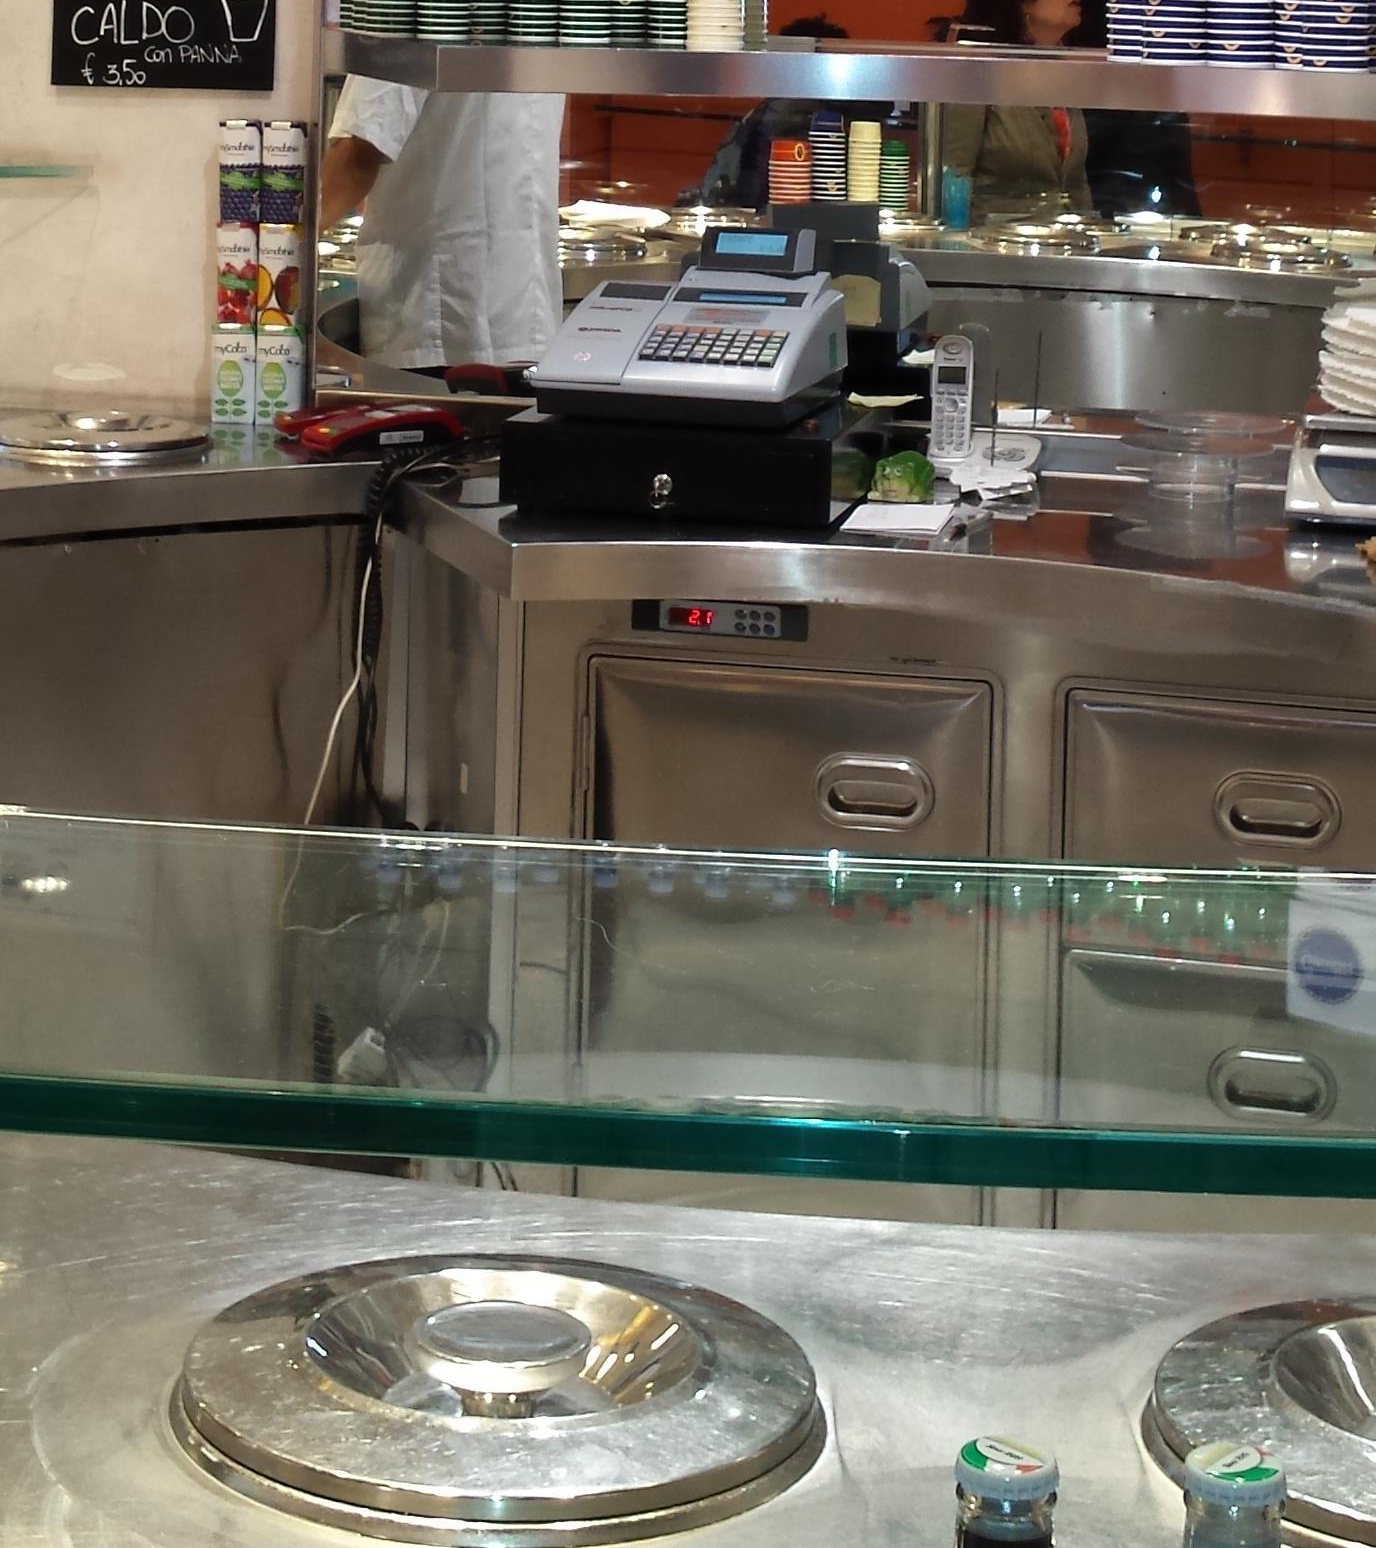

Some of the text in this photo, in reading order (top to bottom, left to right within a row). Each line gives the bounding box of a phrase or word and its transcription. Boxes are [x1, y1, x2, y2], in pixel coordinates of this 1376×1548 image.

[71, 0, 195, 45] CALDO
[81, 52, 146, 86] € 3,50
[178, 43, 243, 64] PANNA
